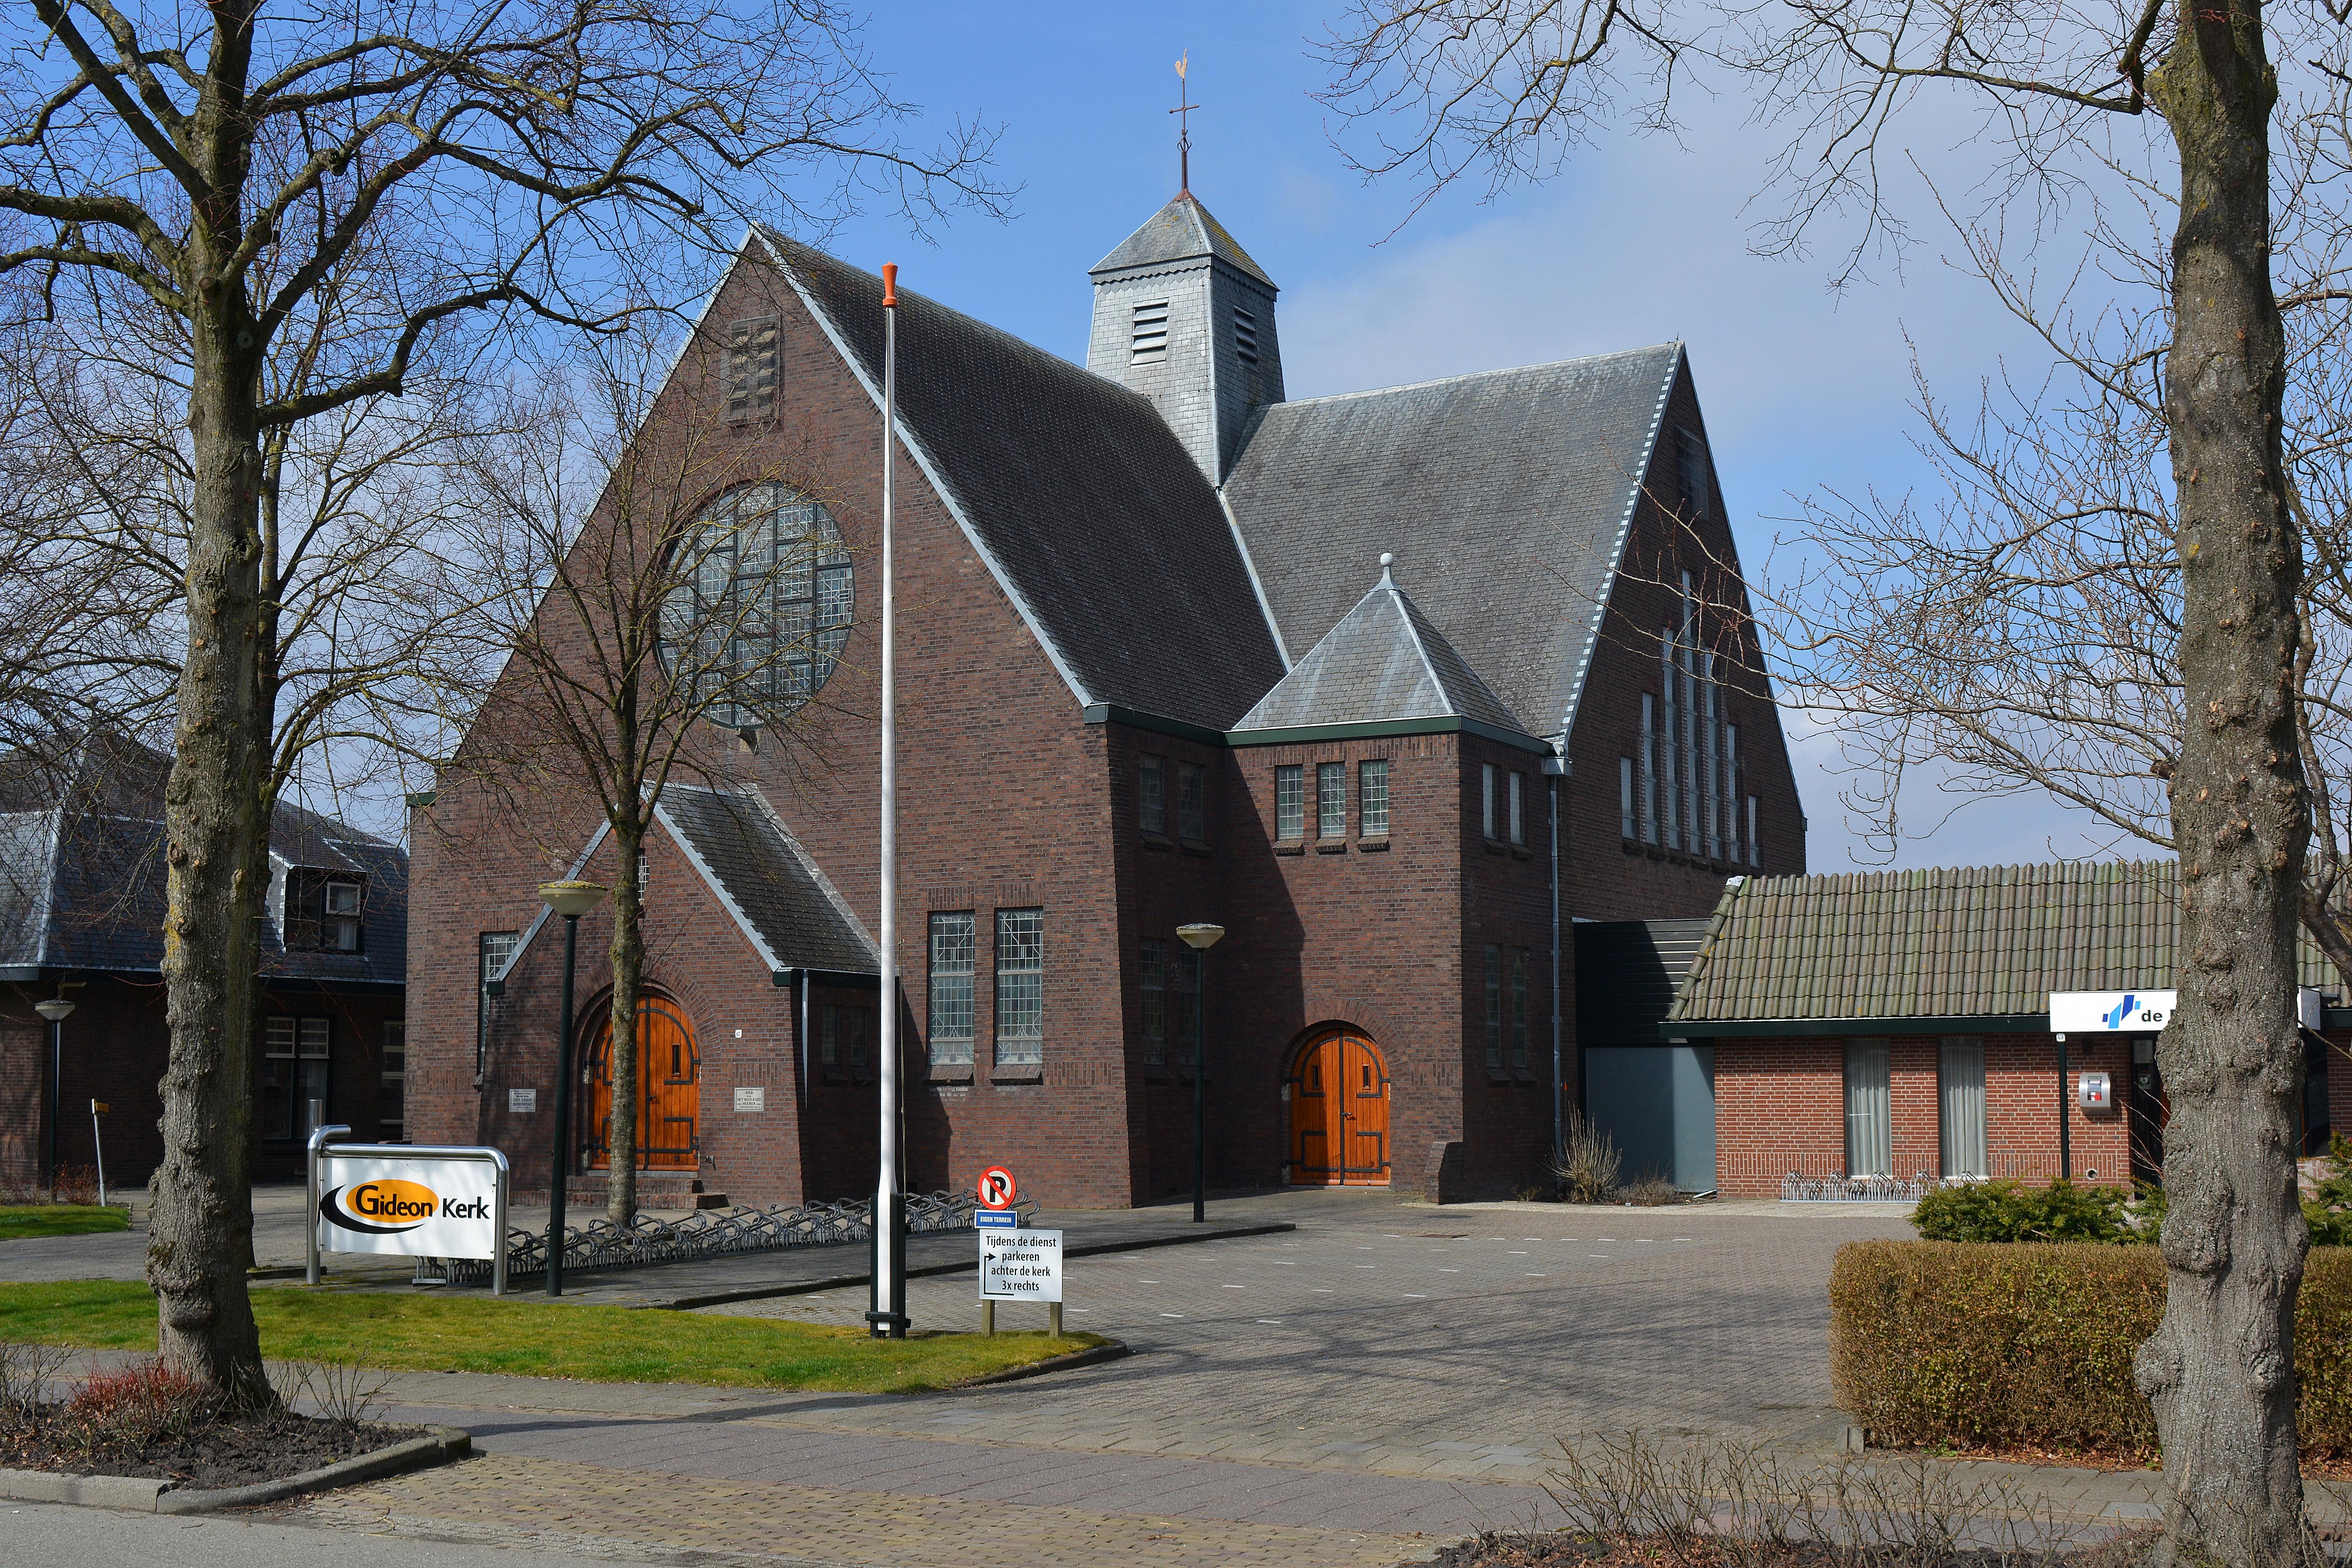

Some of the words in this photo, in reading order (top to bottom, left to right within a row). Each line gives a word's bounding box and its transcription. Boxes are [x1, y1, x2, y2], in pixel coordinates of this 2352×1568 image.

[2141, 1010, 2163, 1022] de
[355, 1185, 432, 1217] Gideon
[442, 1197, 490, 1219] Kerk
[986, 1236, 1016, 1248] Tijdens
[1018, 1236, 1028, 1246] de
[1030, 1236, 1056, 1247] dienst
[1002, 1251, 1040, 1263] parkeren
[991, 1266, 1018, 1276] achter
[1020, 1266, 1030, 1276] de
[1032, 1266, 1050, 1277] kerk
[1002, 1280, 1012, 1290] 3x
[1014, 1281, 1040, 1291] rechts
